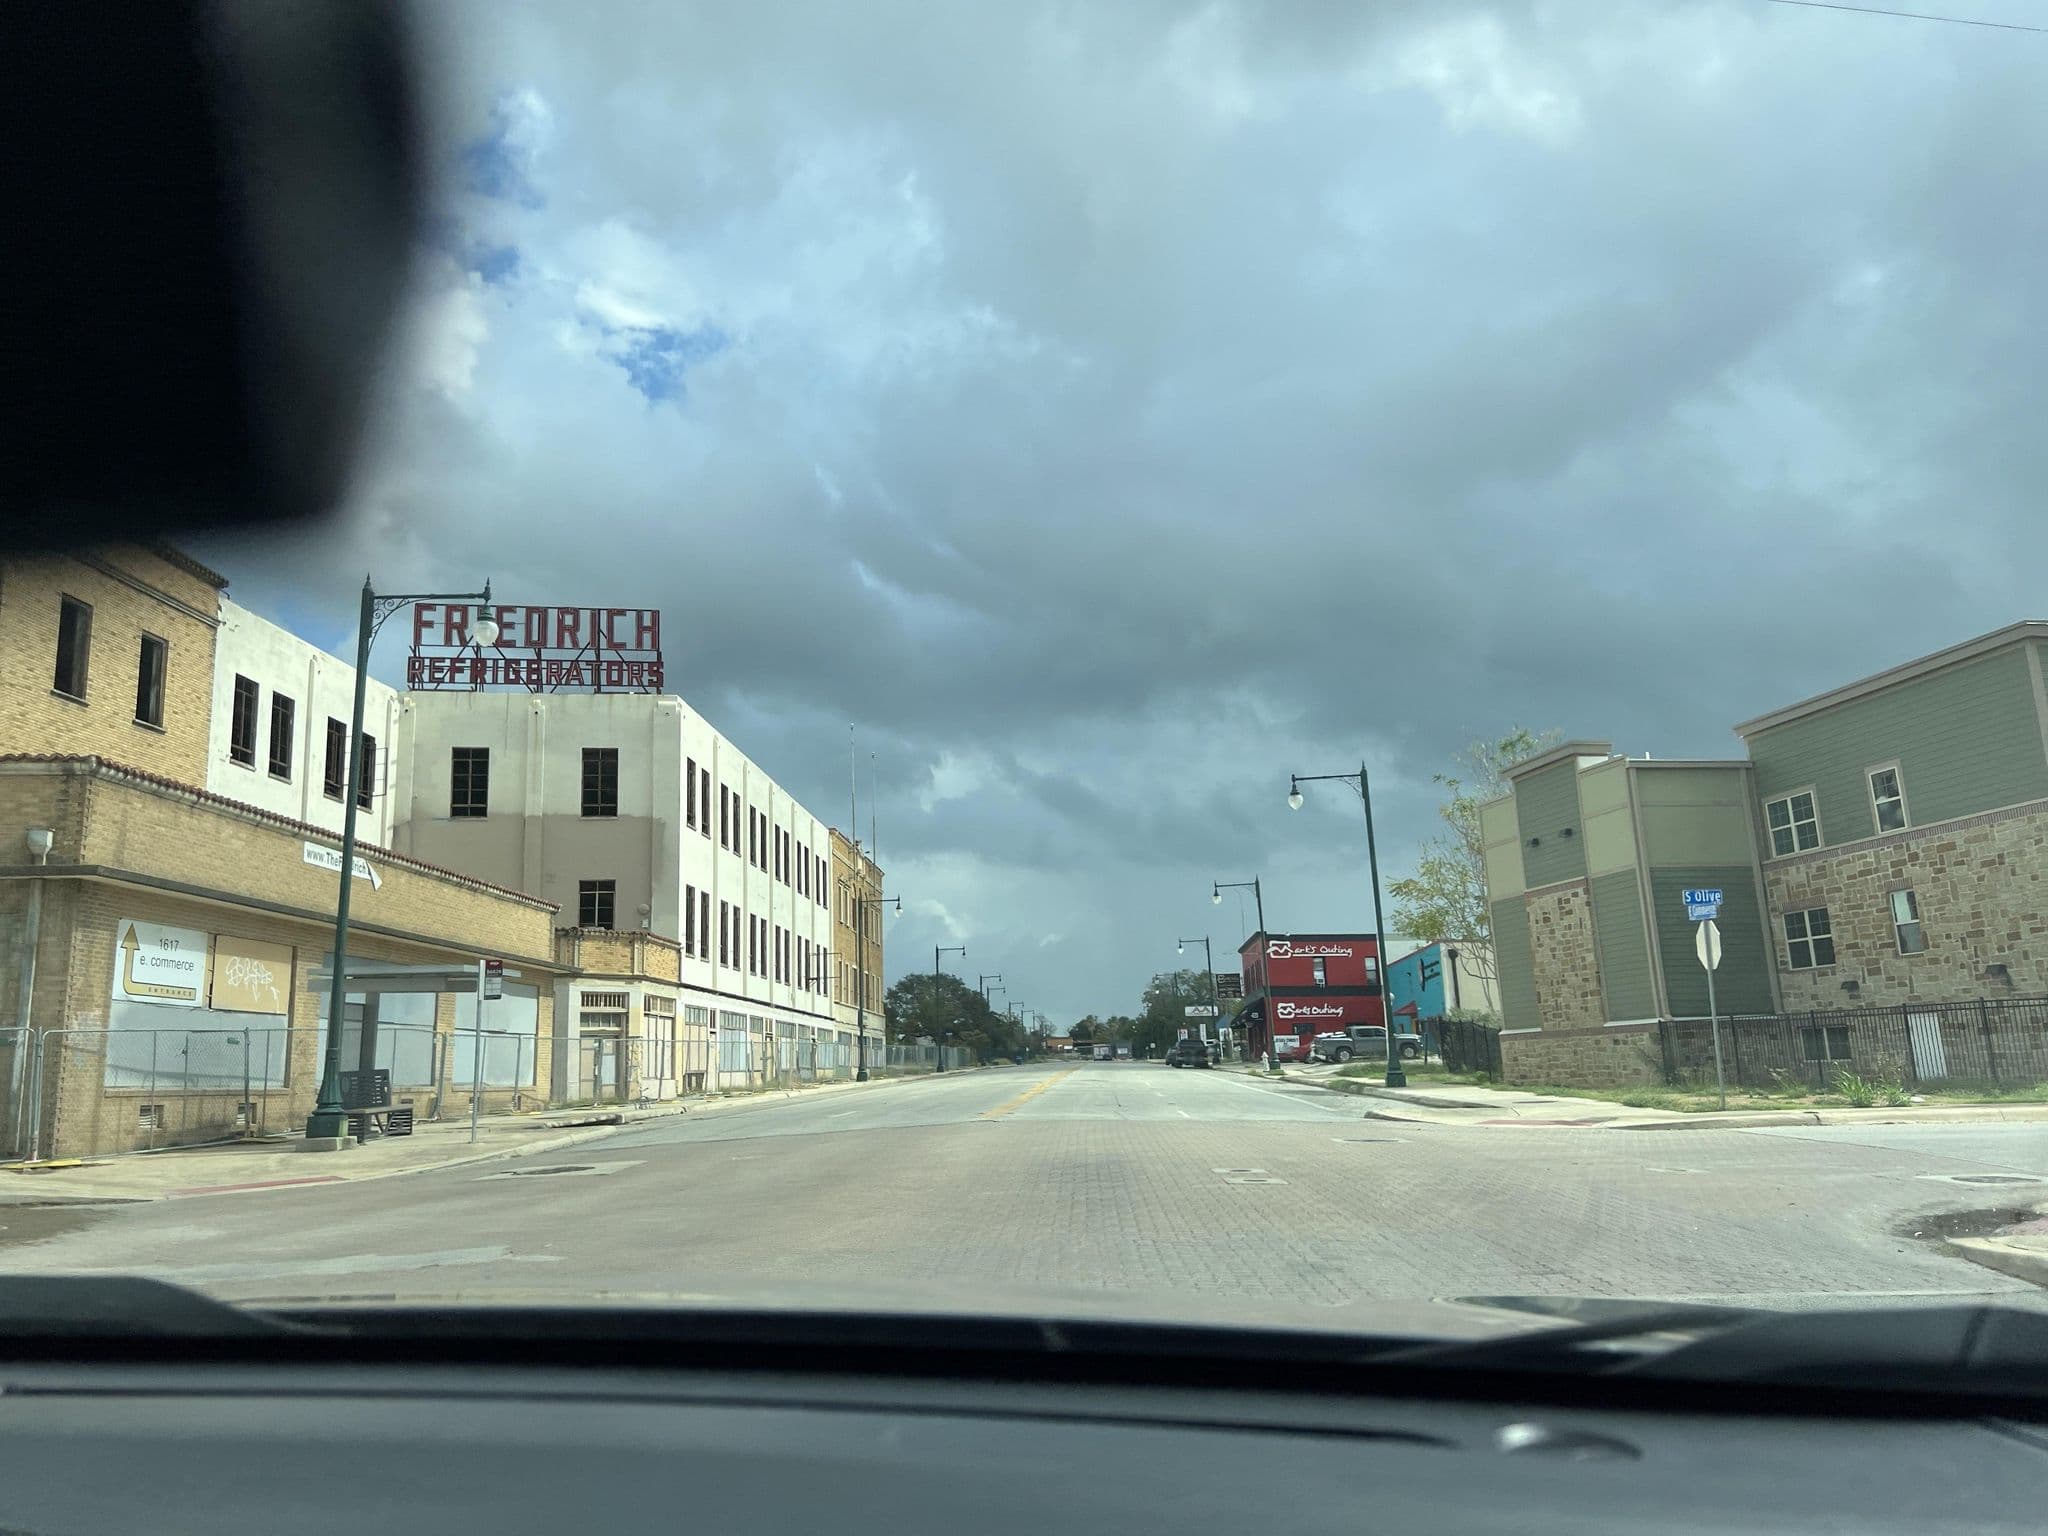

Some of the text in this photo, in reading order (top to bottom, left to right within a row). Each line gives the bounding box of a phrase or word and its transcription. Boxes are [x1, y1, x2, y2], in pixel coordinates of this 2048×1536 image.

[415, 604, 659, 649] FREDRICH
[1685, 890, 1720, 902] S Olive
[159, 939, 180, 951] 1617
[1320, 945, 1353, 957] Outing
[140, 955, 195, 971] e. commerce
[1311, 1003, 1343, 1017] Outing
